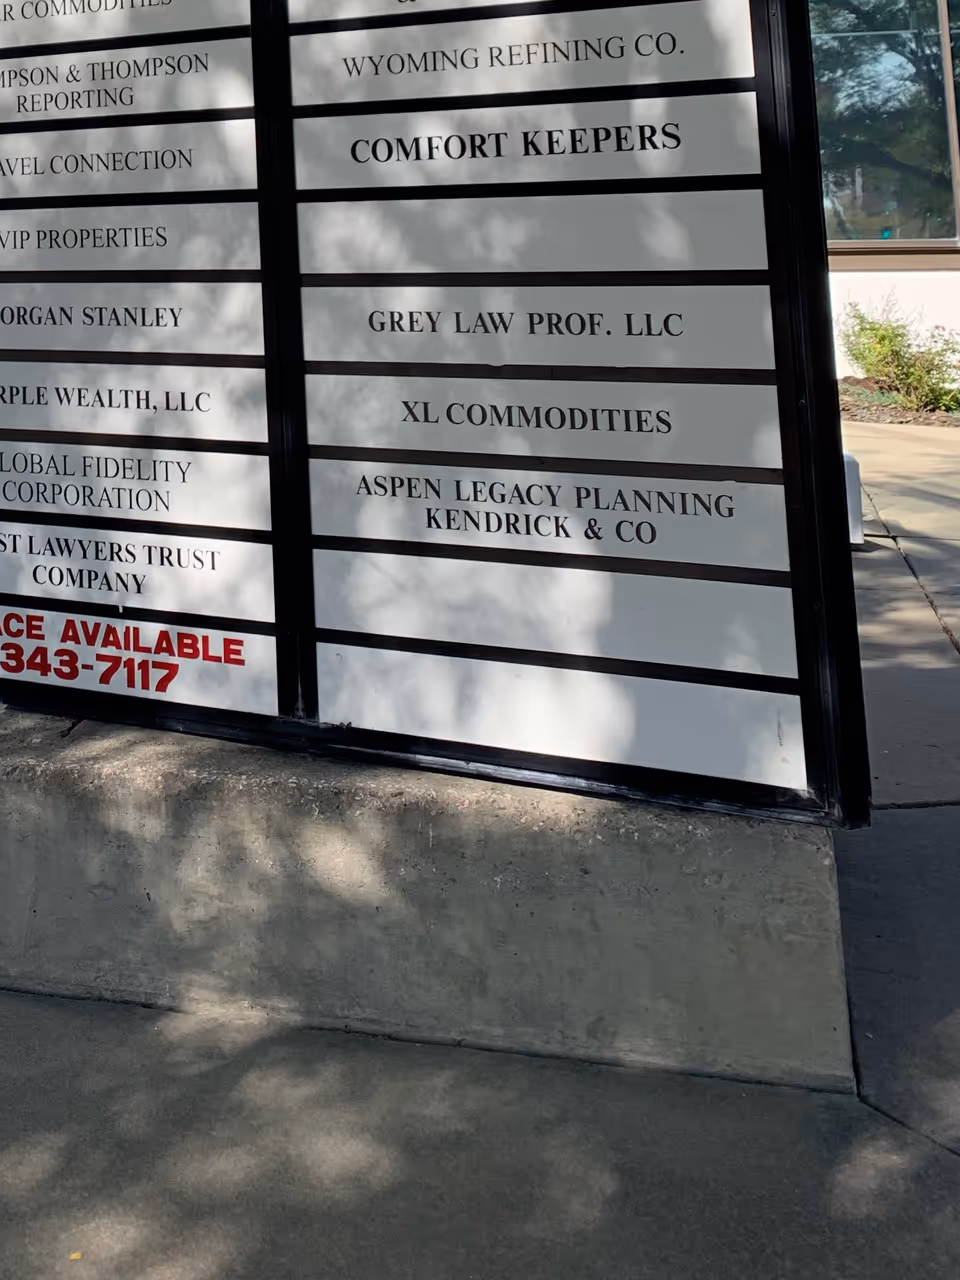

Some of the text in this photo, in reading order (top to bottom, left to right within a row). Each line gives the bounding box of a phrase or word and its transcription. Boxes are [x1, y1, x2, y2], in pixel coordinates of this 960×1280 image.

[66, 65, 81, 82] &
[87, 53, 209, 82] THOMPSON
[343, 32, 685, 77] WYOMING REFINING CO.
[16, 87, 134, 113] REPORTING
[350, 123, 682, 164] COMFORT KEEPERS
[50, 149, 193, 175] CONNECTION
[36, 226, 168, 249] PROPERTIES
[82, 307, 182, 328] STANLEY
[369, 311, 684, 337] GREY LAW PROF. LLC
[54, 388, 158, 414] WEALTH,
[164, 391, 211, 412] LLC
[401, 400, 672, 434] XL COMMODITIES
[82, 456, 192, 483] FIDELITY
[2, 481, 170, 512] CORPORATION
[356, 475, 736, 519] ASPEN LEGACY PLANNING
[425, 508, 657, 544] KENDRICK & CO
[28, 535, 137, 564] LAWYERS
[143, 546, 221, 570] TRUST
[32, 565, 146, 594] COMPANY
[61, 619, 245, 666] AVAILABLE
[0, 642, 179, 693] 343-7117
